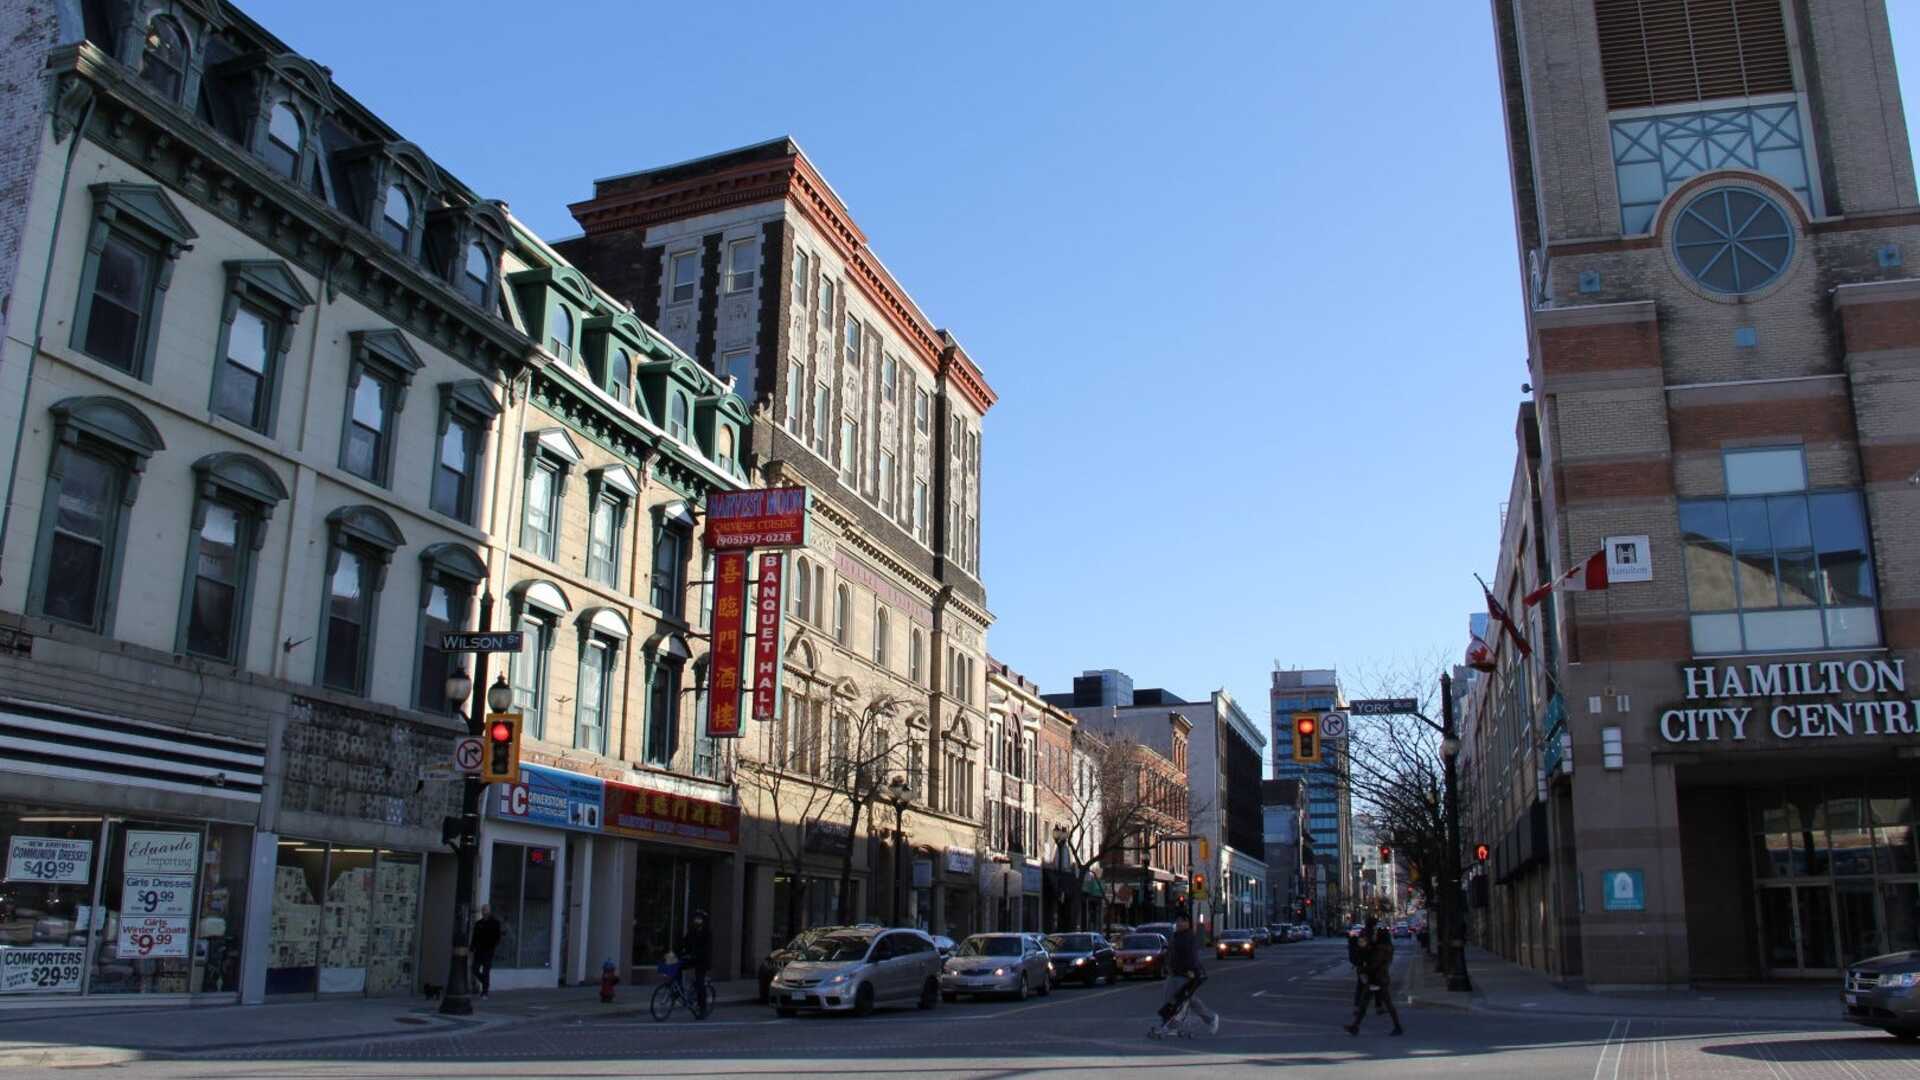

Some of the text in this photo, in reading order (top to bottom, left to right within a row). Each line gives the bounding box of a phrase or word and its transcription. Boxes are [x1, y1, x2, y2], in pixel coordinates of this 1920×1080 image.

[708, 489, 802, 519] HARVEST MOON
[714, 518, 797, 532] CHINESE CUISINE
[1608, 566, 1648, 576] Hamilton
[443, 636, 503, 649] WILSON
[758, 556, 776, 718] BANQUET HALL
[1683, 659, 1905, 700] HAMILTON
[1356, 703, 1392, 713] YORK
[1660, 699, 1920, 743] CITY CENTR
[129, 837, 192, 857] Eduardo
[13, 847, 88, 862] COMMUNION DRESSES
[146, 856, 192, 868] Importing
[24, 860, 75, 879] $49.99
[127, 877, 192, 888] Girls Dresses
[123, 925, 187, 934] Winter Coats
[144, 918, 167, 928] Girls
[5, 951, 82, 966] COMFORTERS
